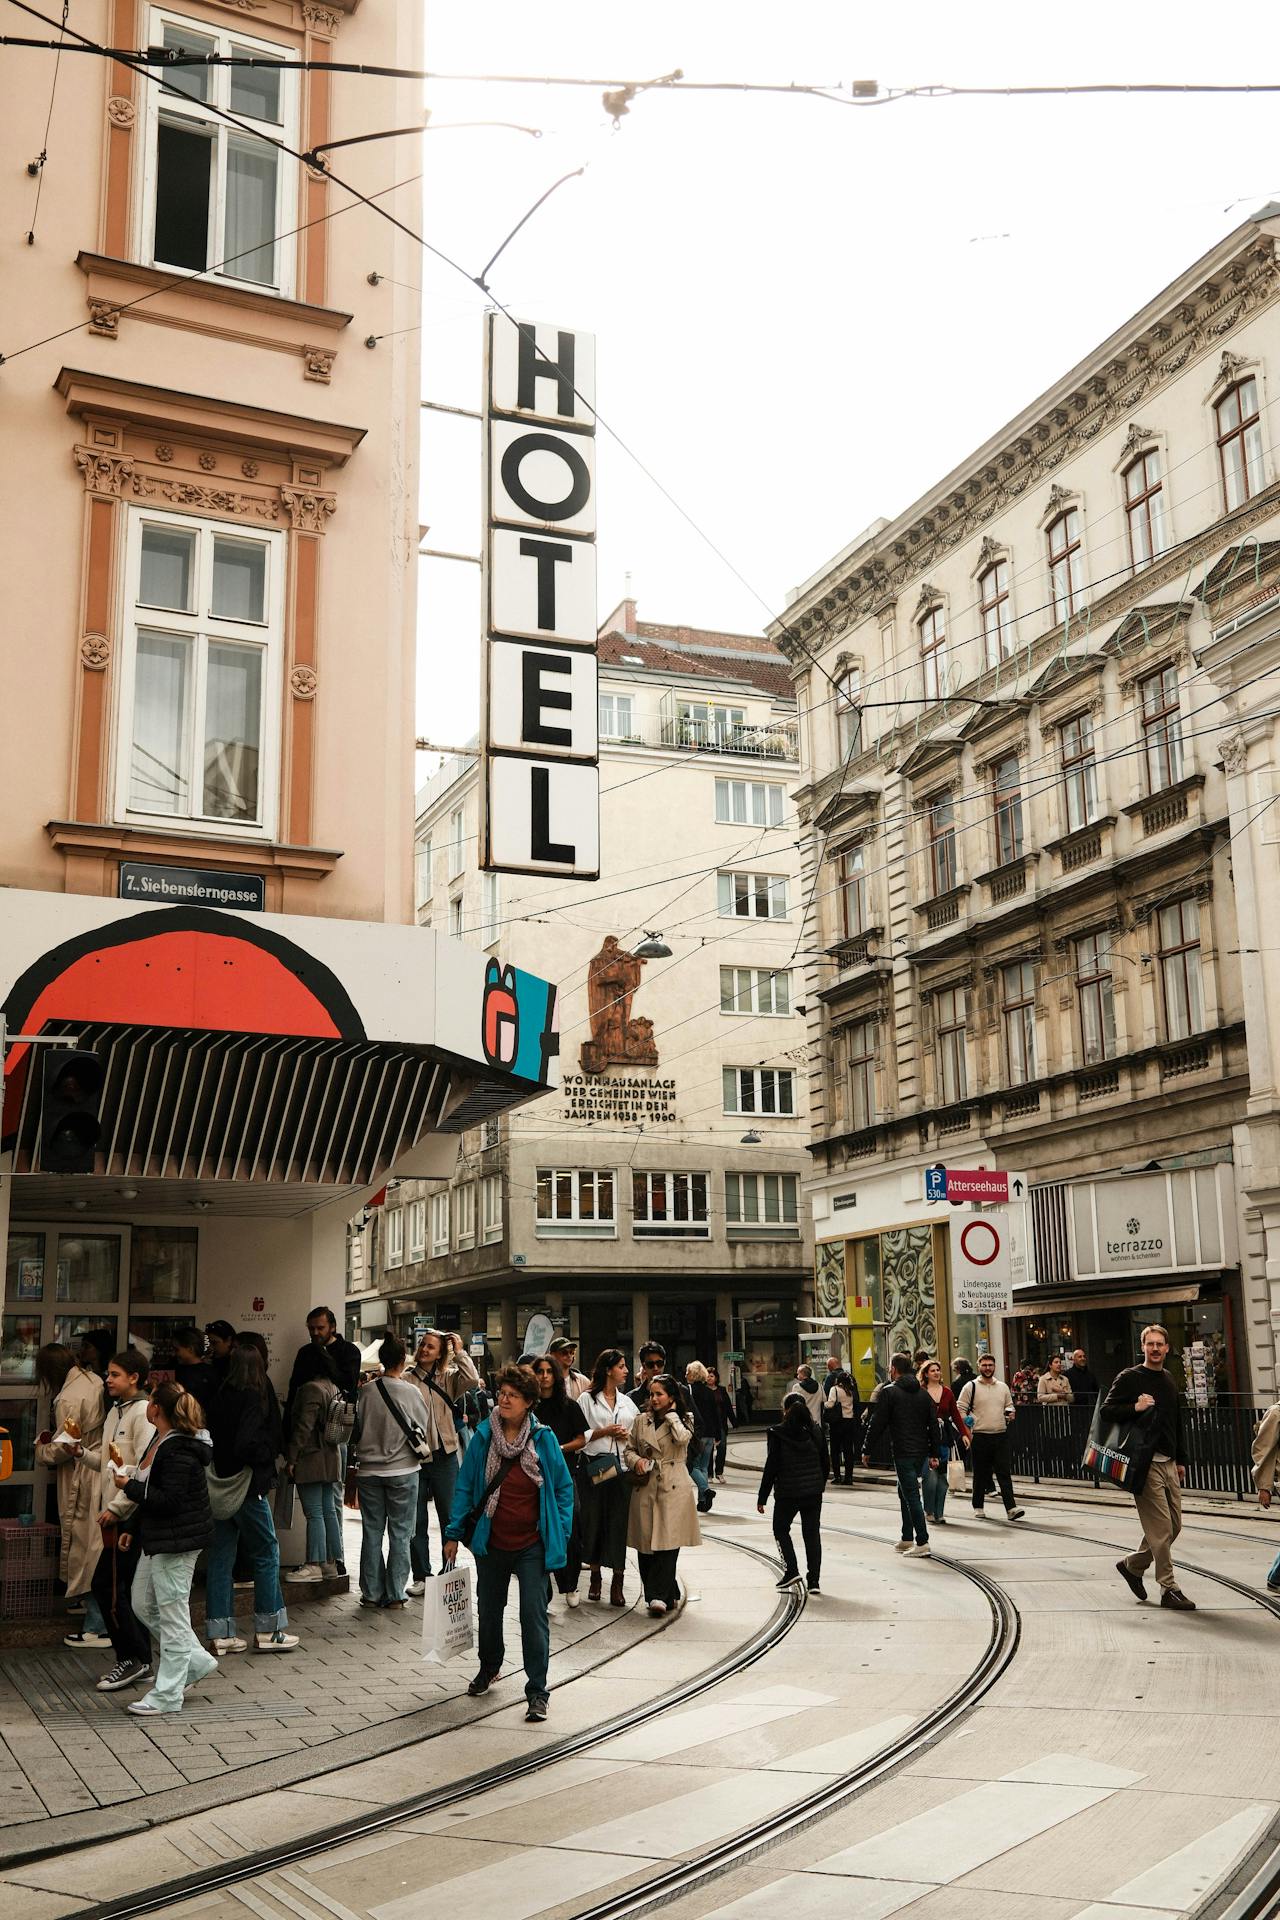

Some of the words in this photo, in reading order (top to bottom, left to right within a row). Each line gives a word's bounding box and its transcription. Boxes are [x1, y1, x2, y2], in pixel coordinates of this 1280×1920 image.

[501, 324, 591, 865] HOTEL
[141, 876, 258, 903] Siebensterngasse
[564, 1087, 587, 1097] DER
[589, 1088, 646, 1099] GEMEINDE
[647, 1089, 677, 1101] WIEN
[571, 1098, 629, 1110] ERRICHTET
[631, 1101, 643, 1110] IN
[646, 1101, 668, 1111] DEN
[564, 1109, 611, 1120] JAHREN
[612, 1111, 638, 1122] 1958
[649, 1112, 676, 1122] 1960
[947, 1179, 1008, 1193] Atterseehaus
[1107, 1238, 1163, 1254] terrazzo
[1136, 1251, 1161, 1260] schenken
[963, 1279, 1001, 1290] Lindengasse
[958, 1290, 966, 1299] ab
[967, 1290, 1008, 1300] Neubaugasse
[443, 1590, 463, 1605] KAUF
[448, 1598, 469, 1615] STADT
